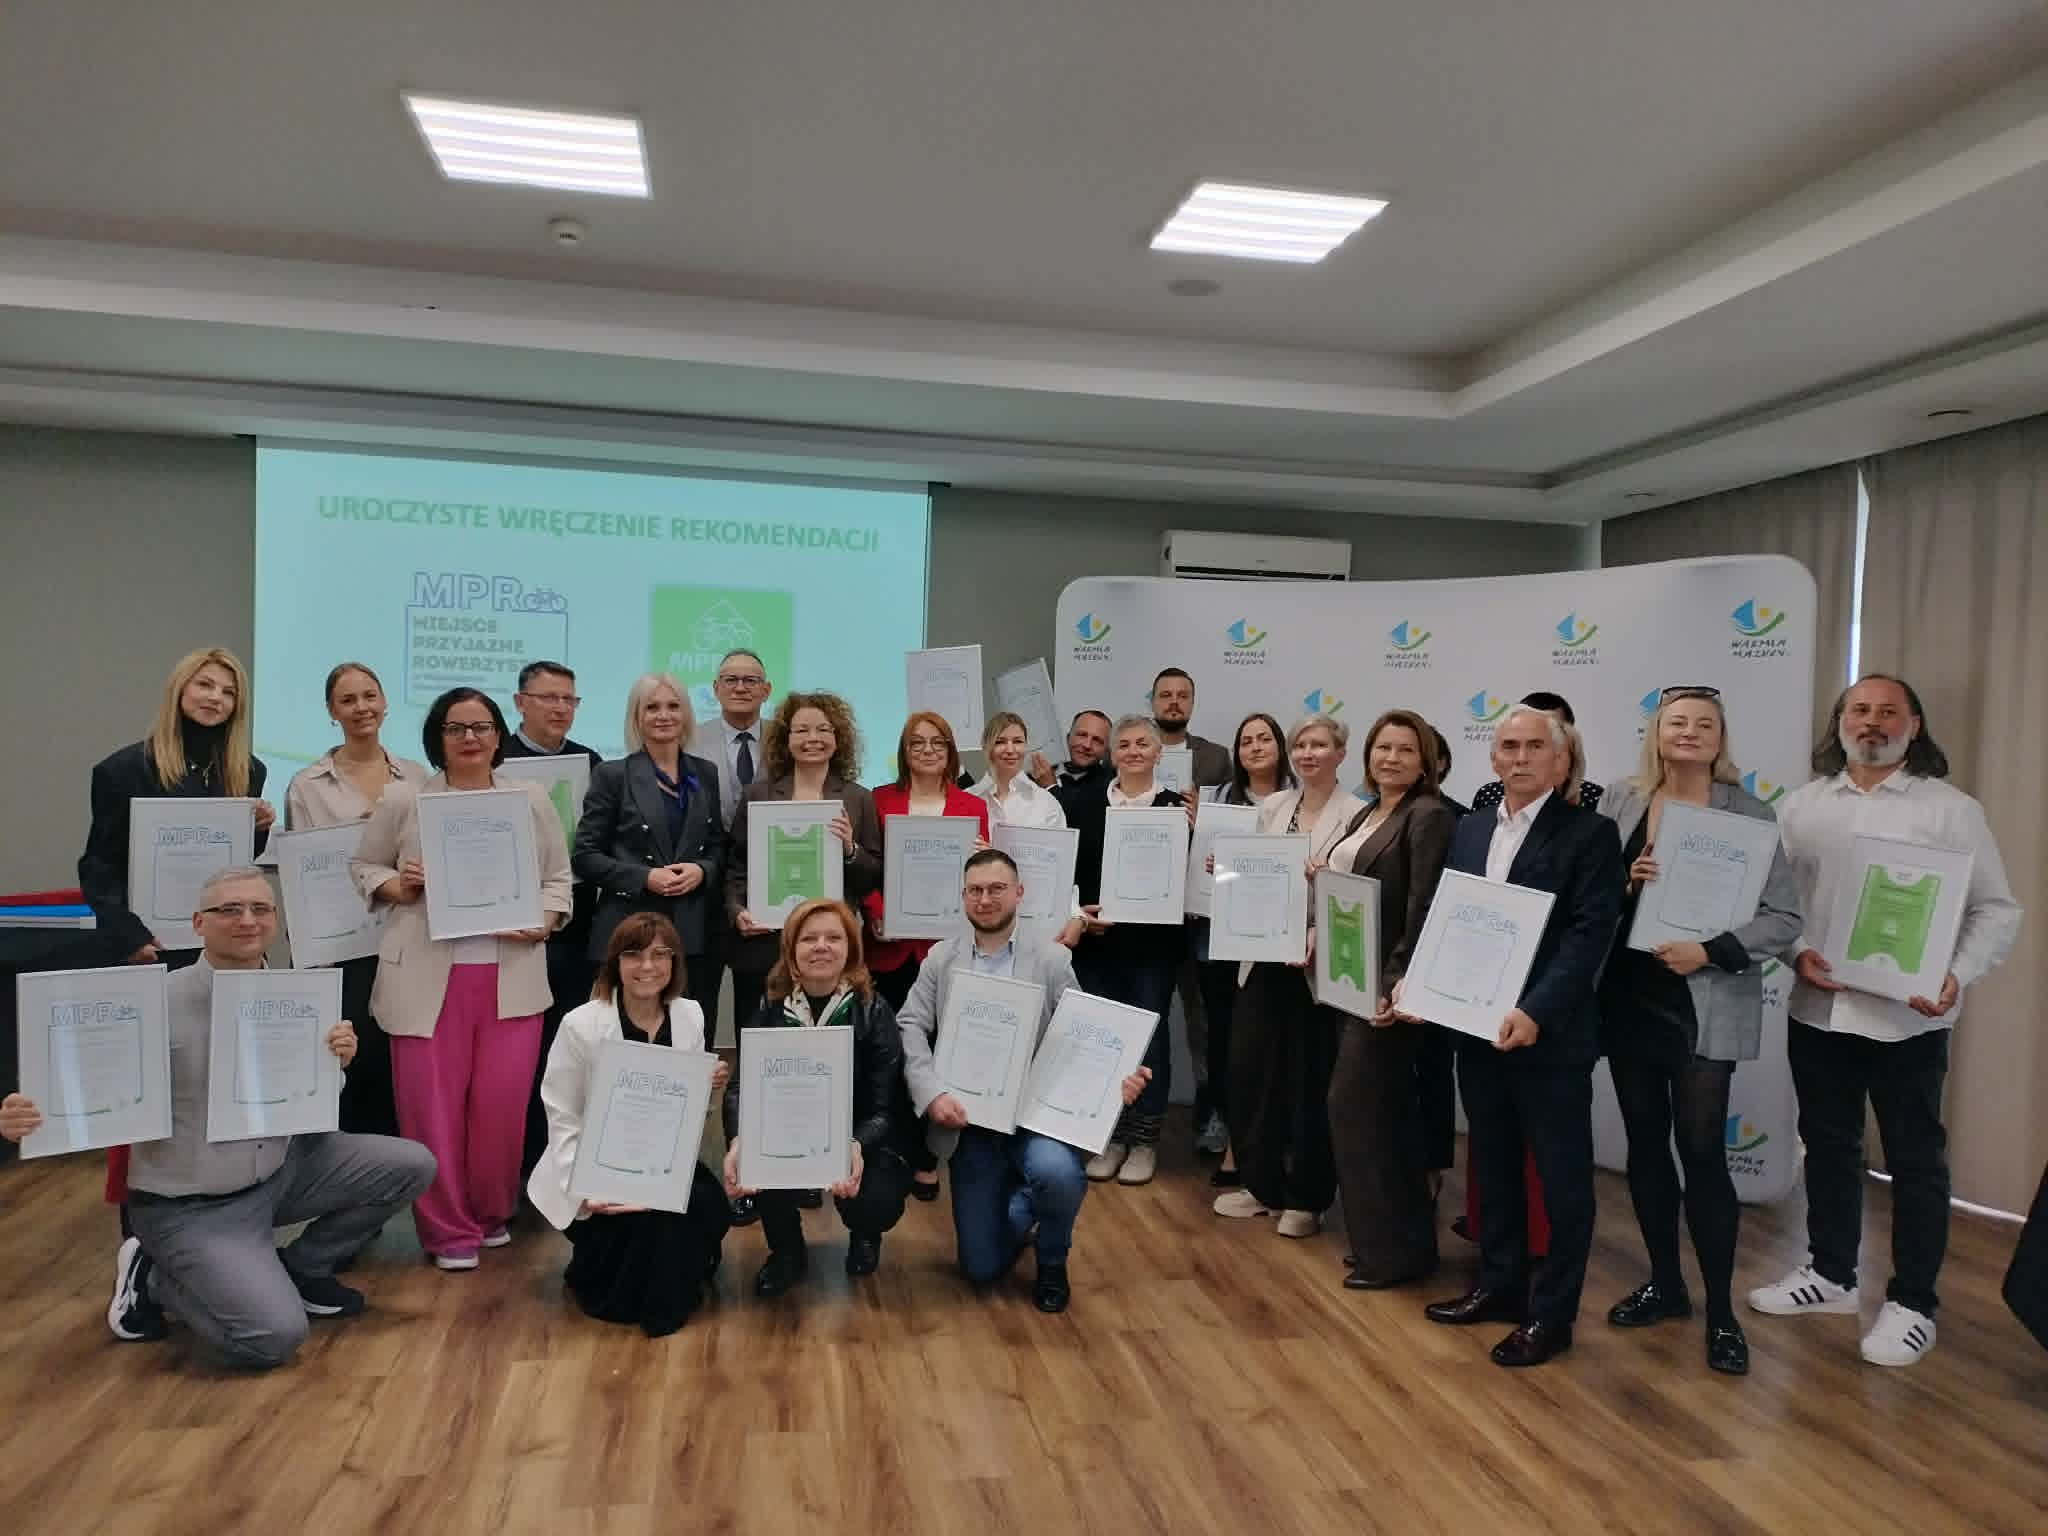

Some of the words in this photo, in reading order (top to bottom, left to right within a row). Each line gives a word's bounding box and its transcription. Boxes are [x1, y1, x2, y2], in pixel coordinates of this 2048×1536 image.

[319, 495, 488, 528] UROCZYSTE
[497, 504, 662, 541] WRĘCZENIE
[671, 518, 879, 553] REKOMENDACJI
[413, 570, 523, 612] MPR
[412, 615, 498, 634] MIEJSCE
[412, 634, 525, 655] PRZYJAZNE
